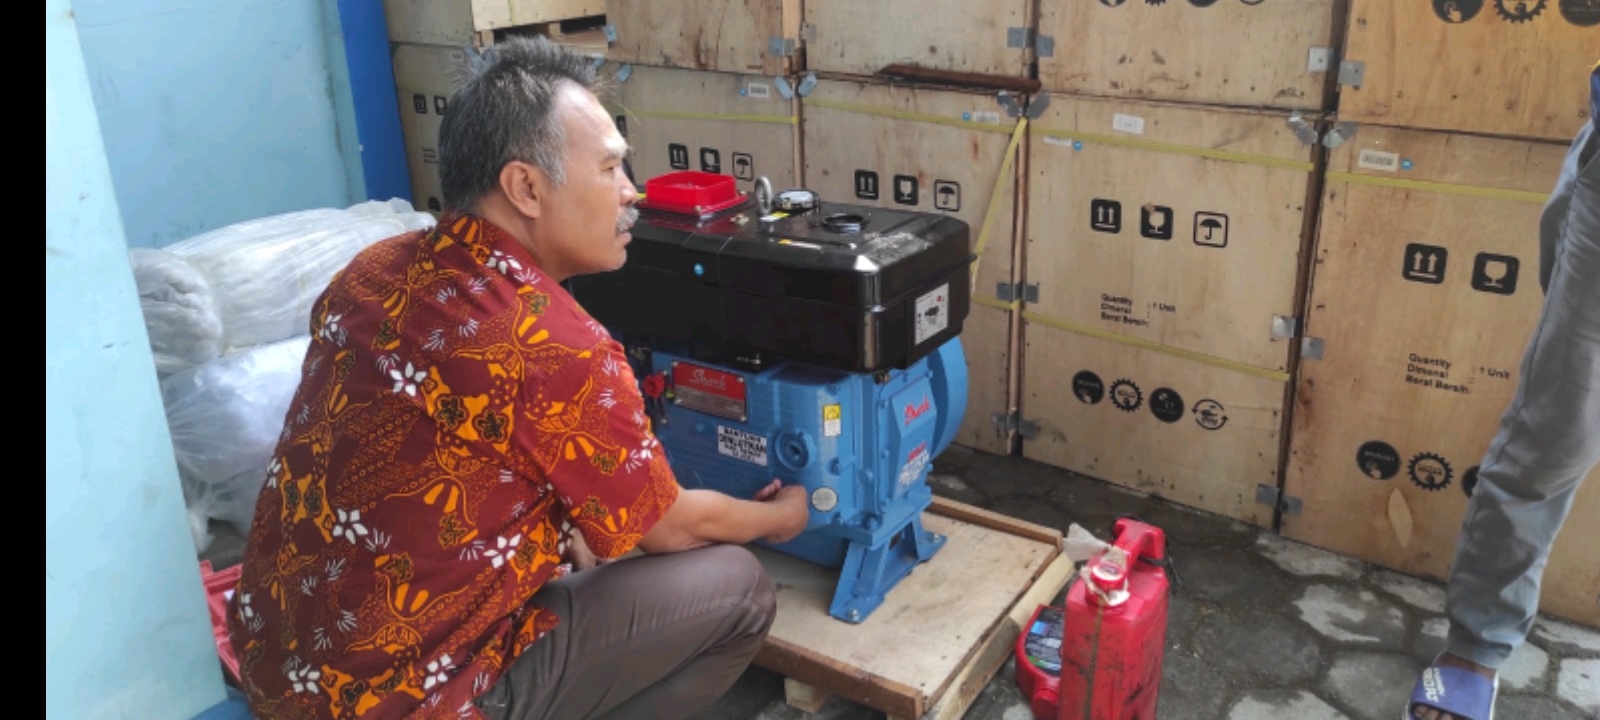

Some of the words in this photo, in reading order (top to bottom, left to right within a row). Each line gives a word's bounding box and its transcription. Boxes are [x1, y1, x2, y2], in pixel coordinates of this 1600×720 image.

[1101, 293, 1133, 306] Quantity
[1407, 363, 1449, 379] Dimensi
[1409, 353, 1451, 370] Quantity
[1487, 367, 1510, 380] Unit
